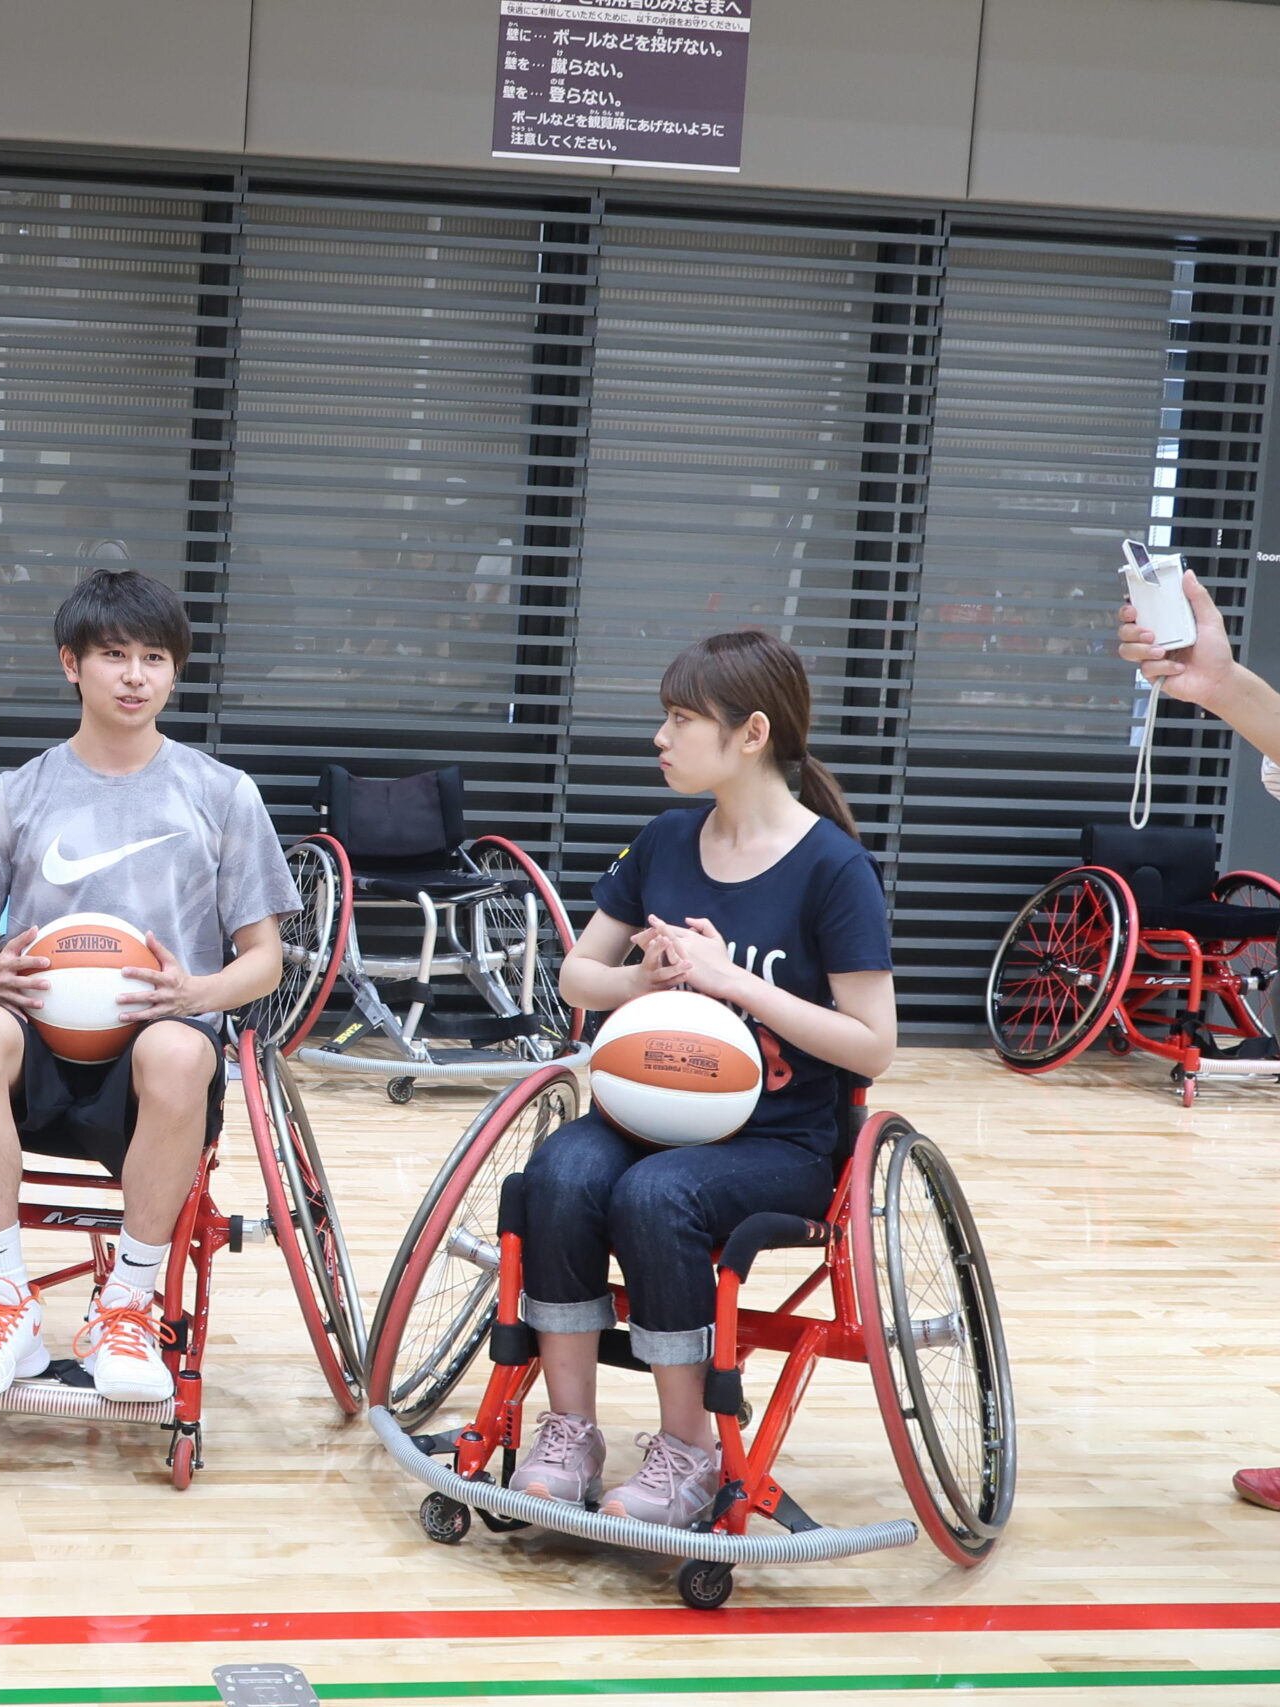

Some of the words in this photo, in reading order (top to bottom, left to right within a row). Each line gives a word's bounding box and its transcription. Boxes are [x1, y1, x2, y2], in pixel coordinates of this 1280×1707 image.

[512, 110, 725, 137] ボールなどを観覧席にあげないように
[510, 132, 617, 152] 注意してください。
[56, 934, 122, 953] TACHIKARA
